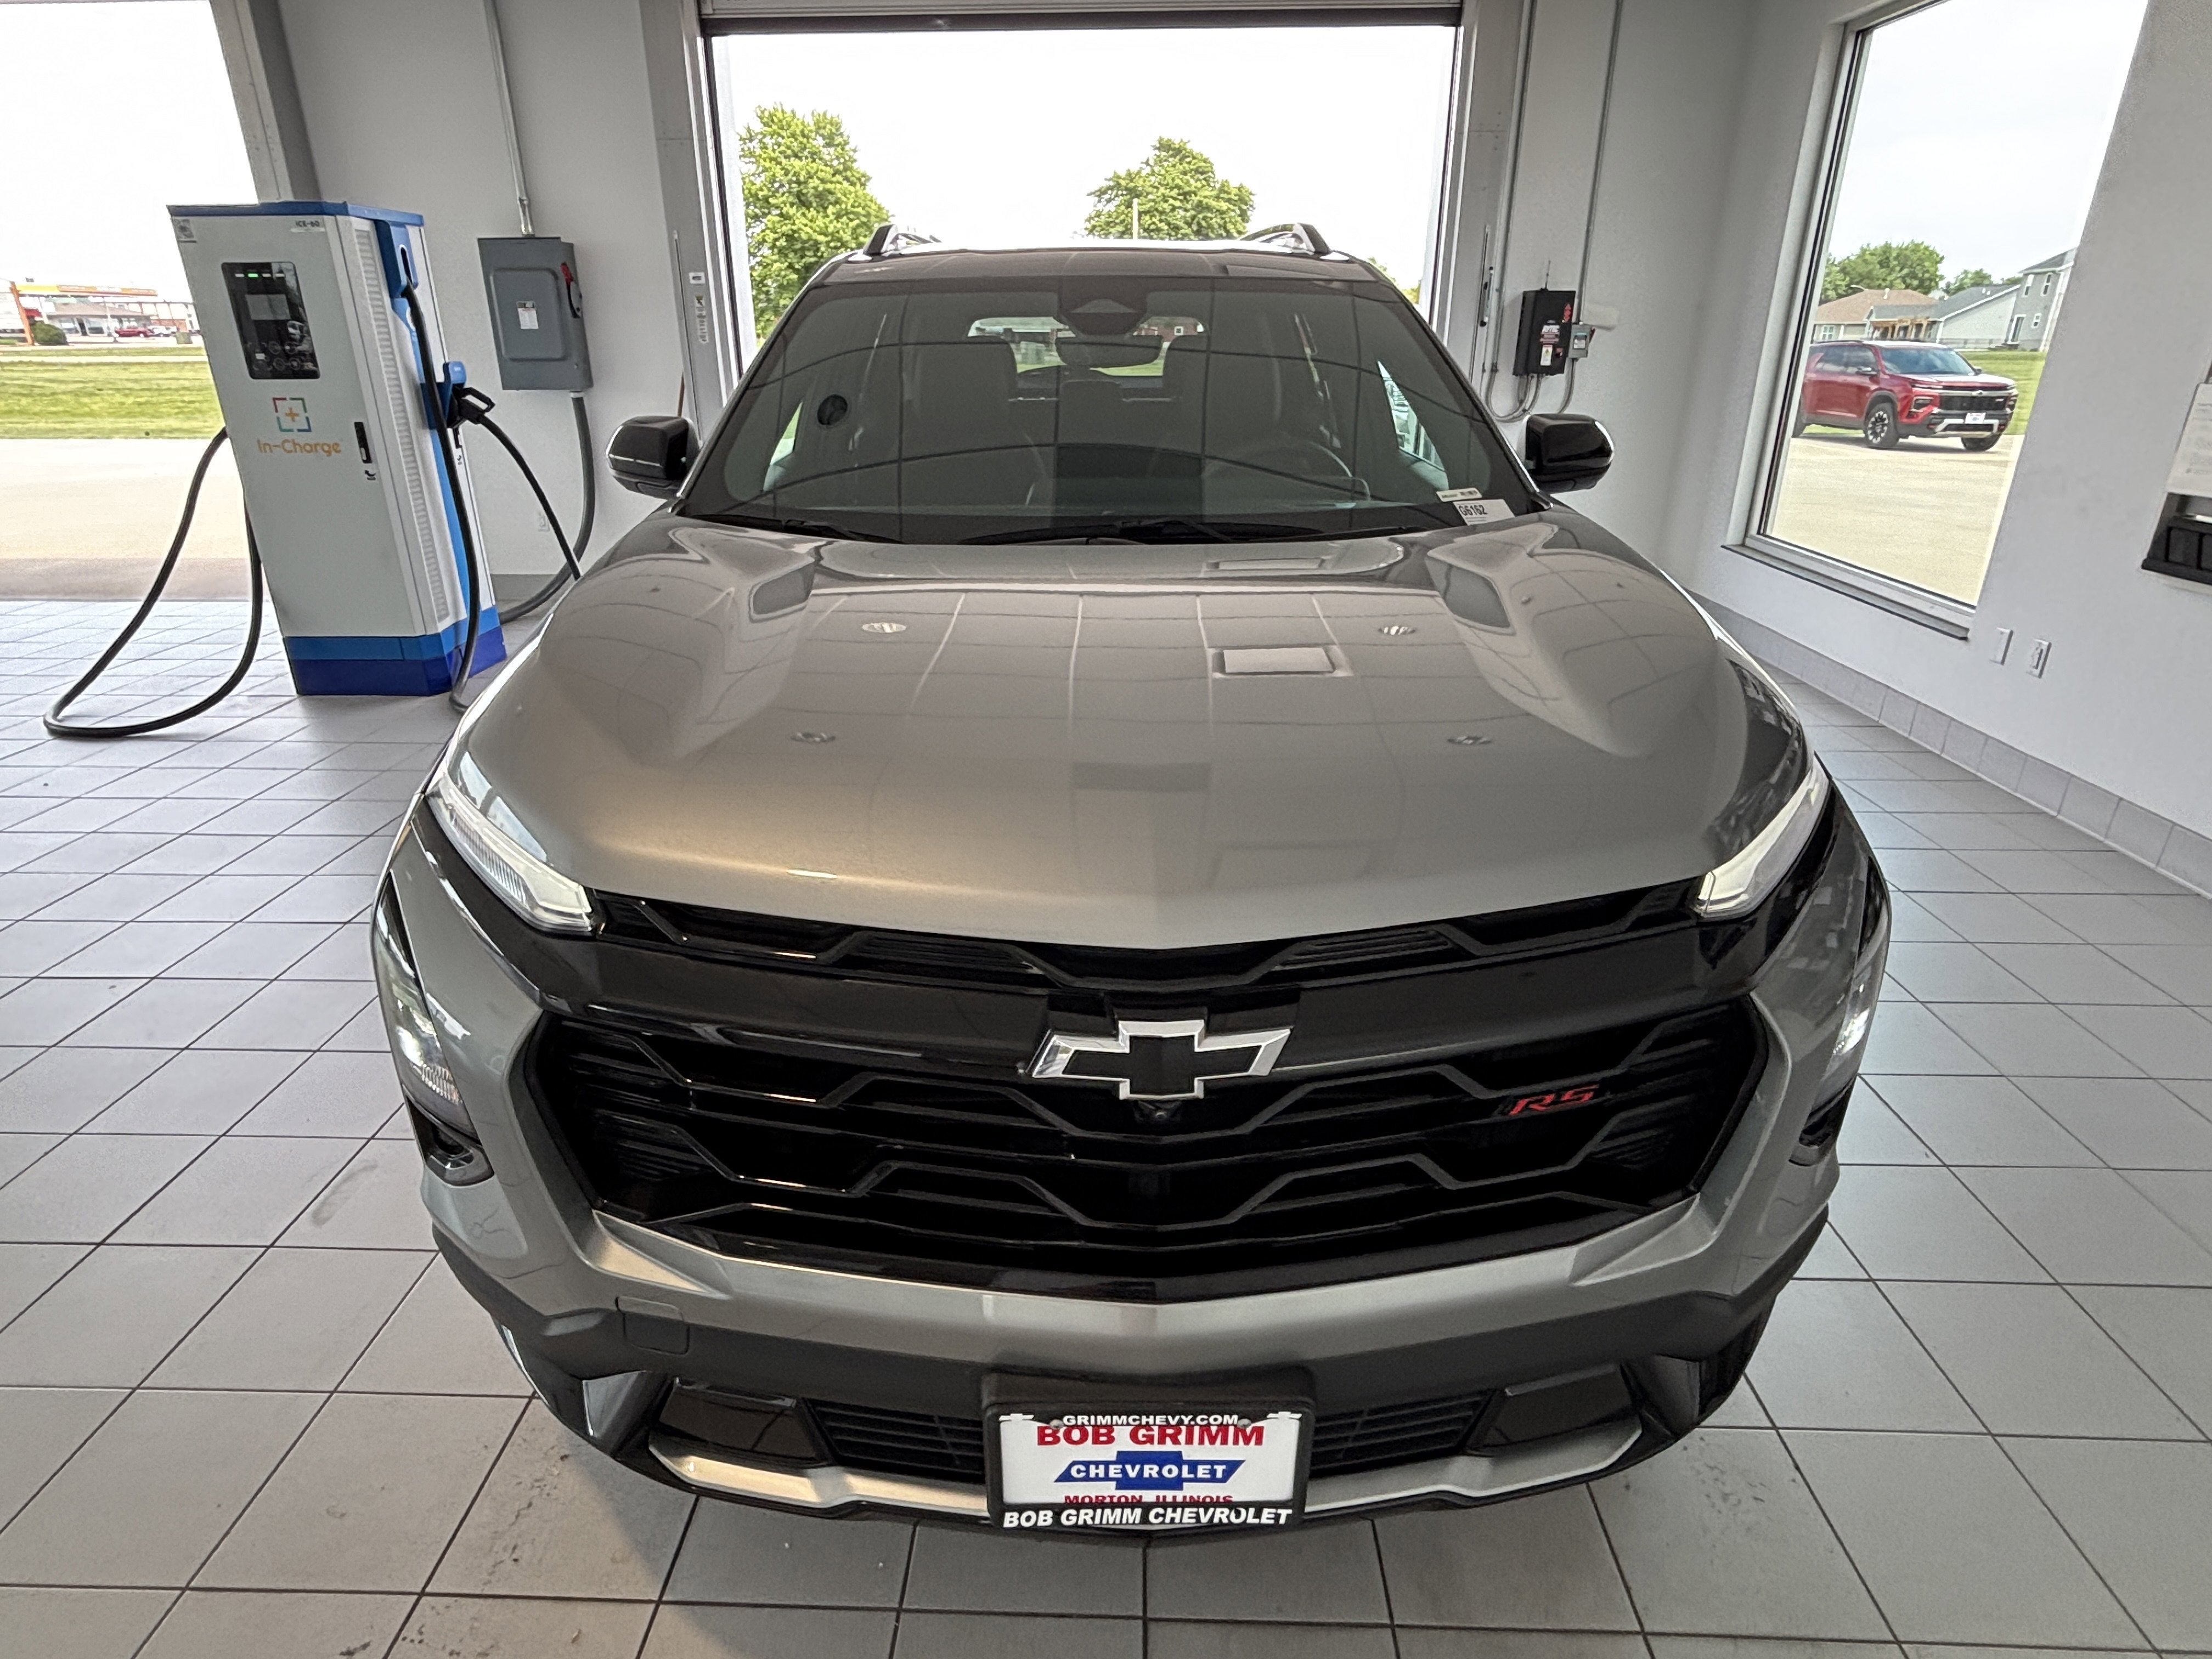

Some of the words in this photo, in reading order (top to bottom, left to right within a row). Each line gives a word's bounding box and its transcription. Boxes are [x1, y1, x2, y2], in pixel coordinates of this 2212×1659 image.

[257, 438, 342, 458] In-Charge
[1458, 505, 1488, 516] G6162
[1509, 1084, 1600, 1115] RS
[1063, 1414, 1239, 1426] GRIMMCHEVY.COM
[1037, 1425, 1116, 1446] BOB
[1129, 1425, 1264, 1446] GRIMM
[1070, 1464, 1227, 1479] CHEVROLET
[1003, 1510, 1053, 1528] BOB
[1060, 1508, 1142, 1526] GRIMM
[1148, 1507, 1293, 1525] CHEVROLET
